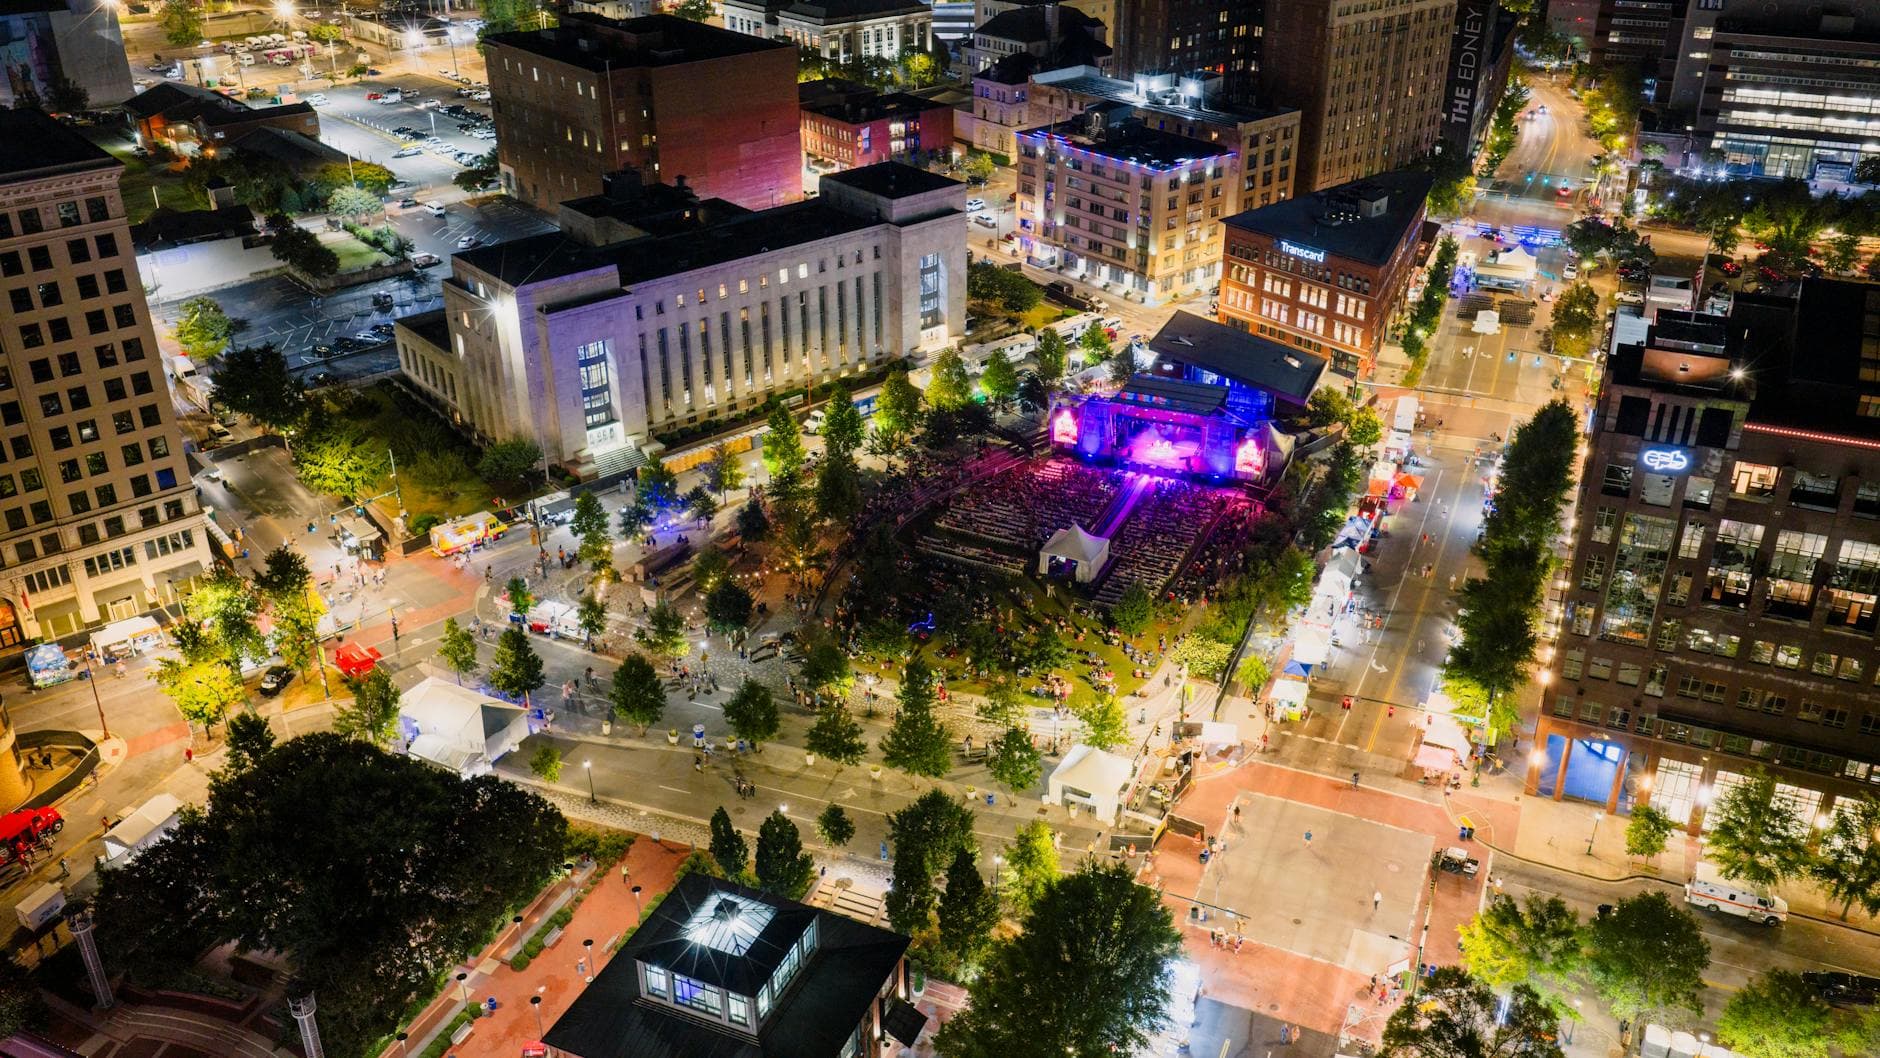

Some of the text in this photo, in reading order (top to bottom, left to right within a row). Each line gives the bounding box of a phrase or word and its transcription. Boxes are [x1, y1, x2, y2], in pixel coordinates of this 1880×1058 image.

[1450, 7, 1482, 123] THE EDNEY
[1281, 241, 1325, 263] Transcard
